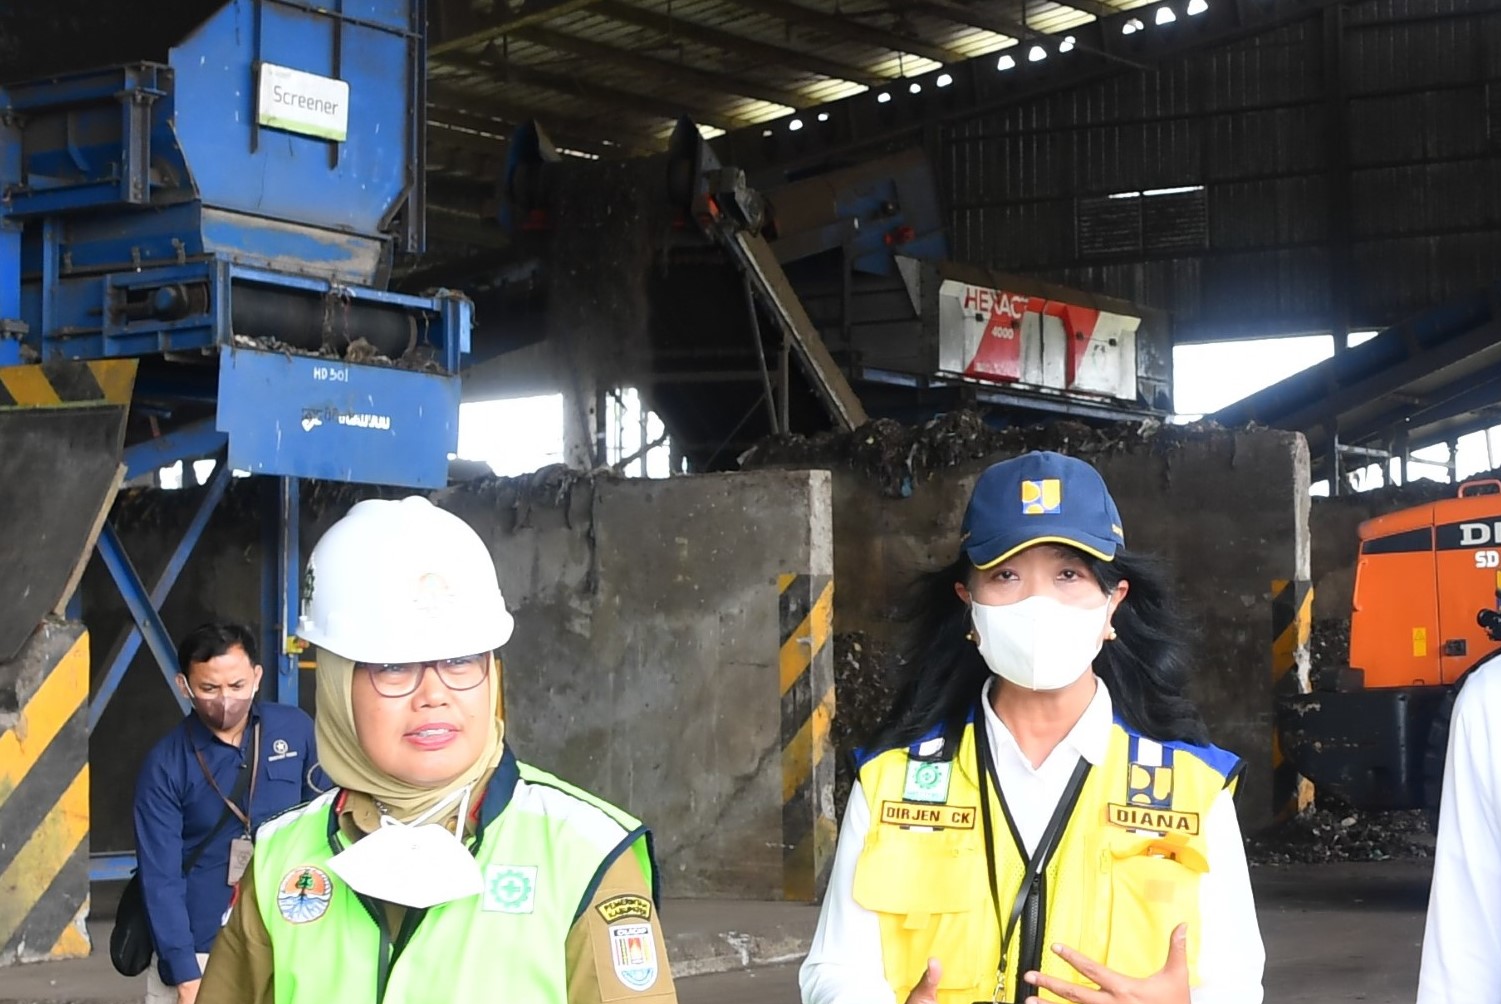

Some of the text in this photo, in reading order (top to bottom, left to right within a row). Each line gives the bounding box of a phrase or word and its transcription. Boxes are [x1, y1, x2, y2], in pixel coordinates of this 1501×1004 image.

[273, 85, 339, 115] Screener
[991, 326, 1015, 340] 4000
[1475, 550, 1499, 568] SD
[886, 806, 971, 824] DIRJEN CK
[1116, 809, 1190, 831] DIANA
